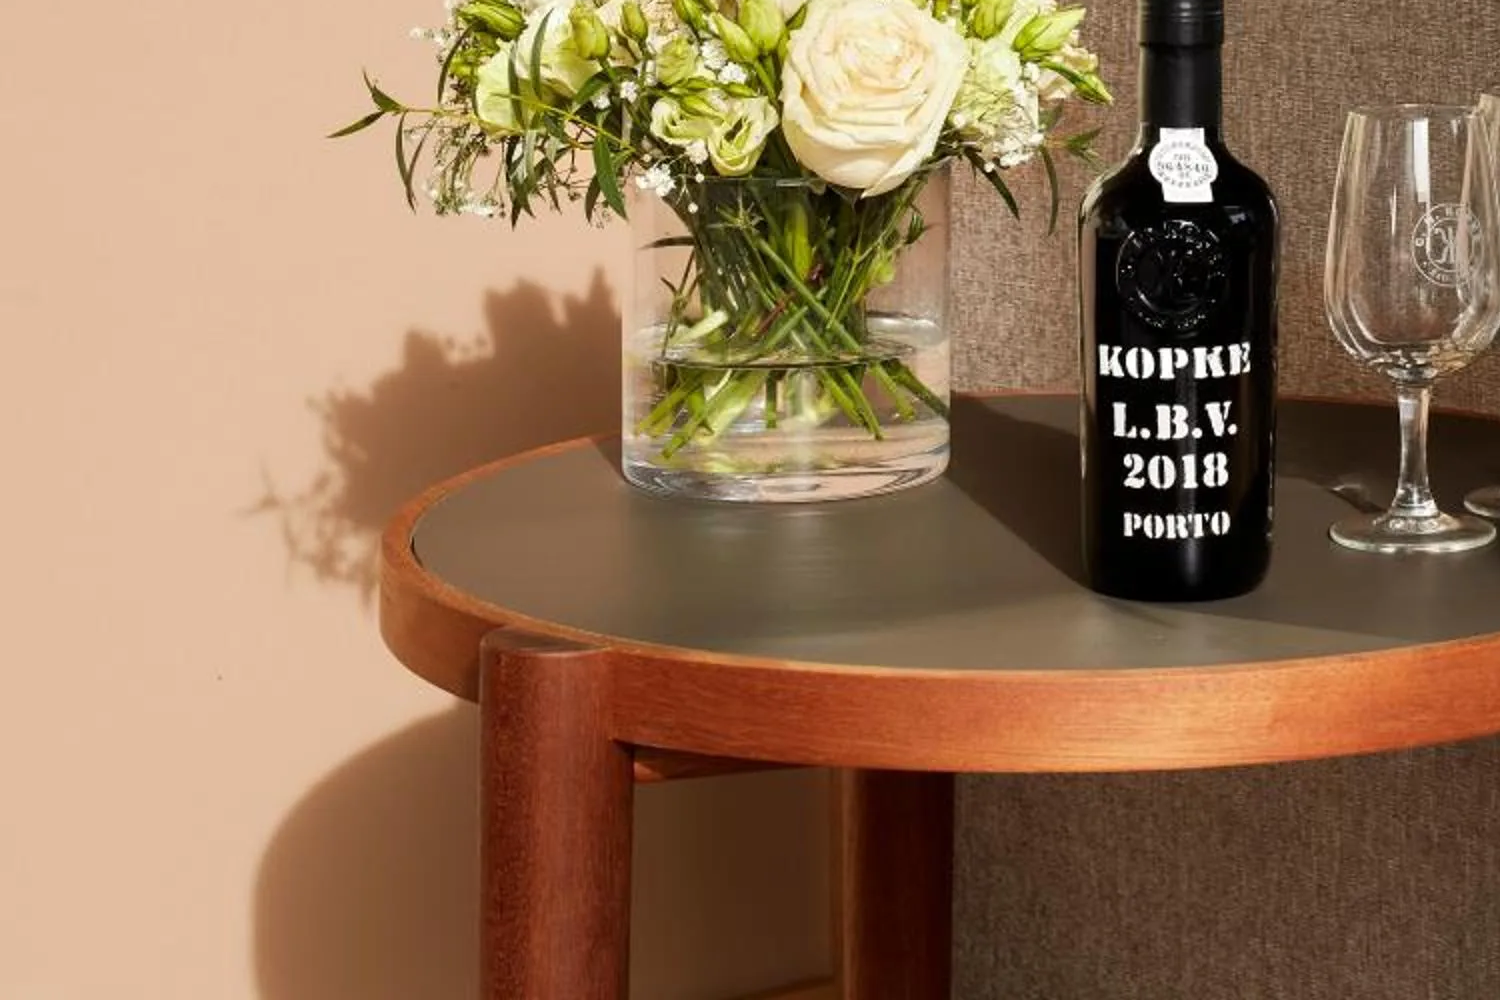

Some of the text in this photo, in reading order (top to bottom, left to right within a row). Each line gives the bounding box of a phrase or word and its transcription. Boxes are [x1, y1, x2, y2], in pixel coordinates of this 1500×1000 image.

[1099, 342, 1251, 380] KOPKE
[1113, 401, 1238, 440] L.B.V.
[1123, 452, 1229, 490] 2018
[1123, 511, 1231, 539] PORTO
